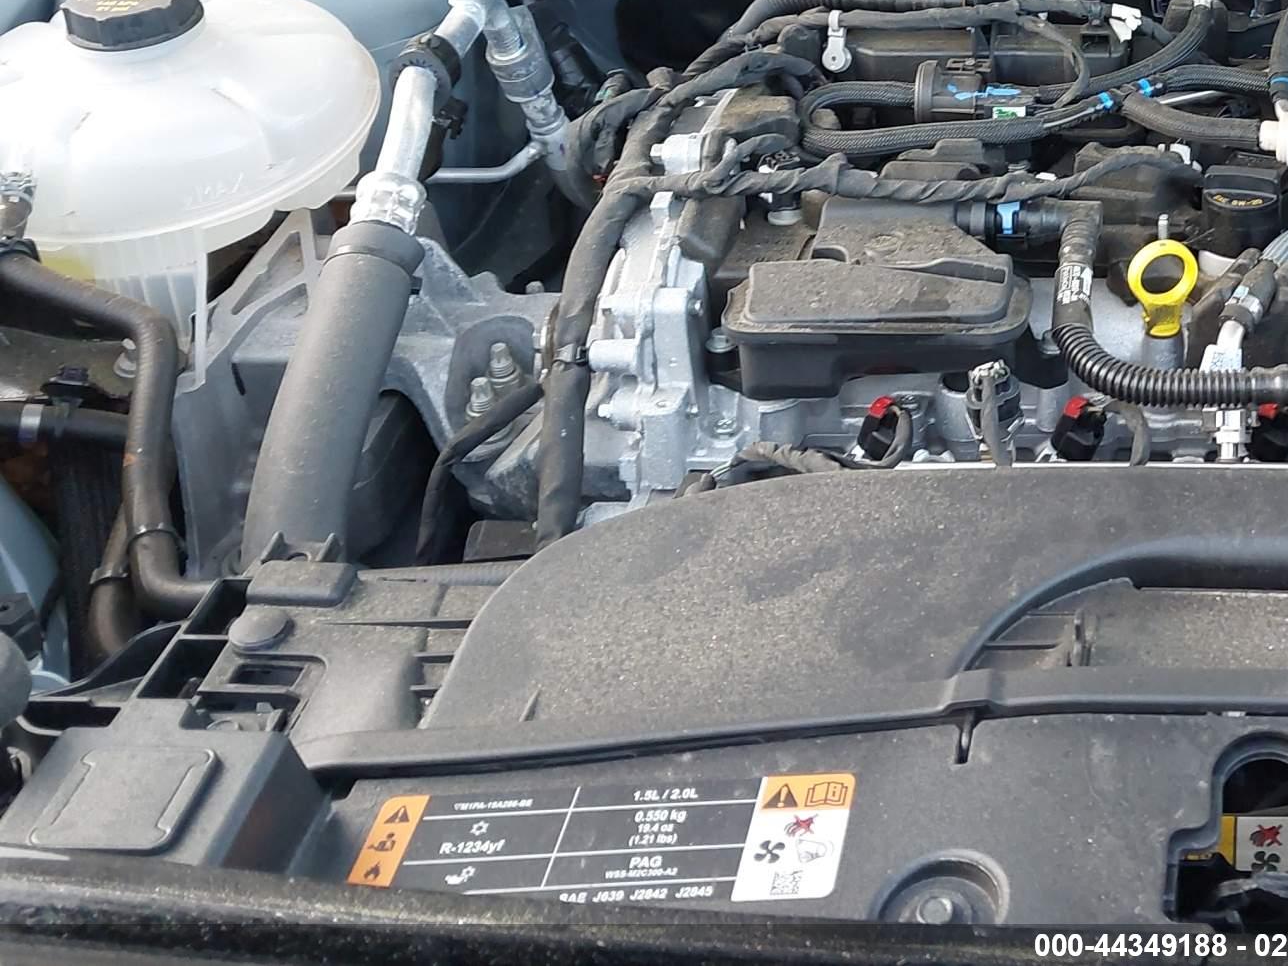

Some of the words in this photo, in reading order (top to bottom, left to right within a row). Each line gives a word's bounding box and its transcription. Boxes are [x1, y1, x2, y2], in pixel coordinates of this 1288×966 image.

[633, 790, 660, 802] 1.5L
[670, 788, 699, 800] 2.0L
[634, 811, 668, 823] 0.550
[670, 810, 688, 823] kg
[637, 823, 660, 834] 19.4
[660, 823, 675, 833] oz
[439, 838, 506, 855] R-1234yf
[628, 835, 654, 847] (1.21
[656, 834, 678, 845] lbs)
[629, 856, 663, 869] PAG
[592, 890, 625, 903] J639
[629, 888, 668, 901] J2842
